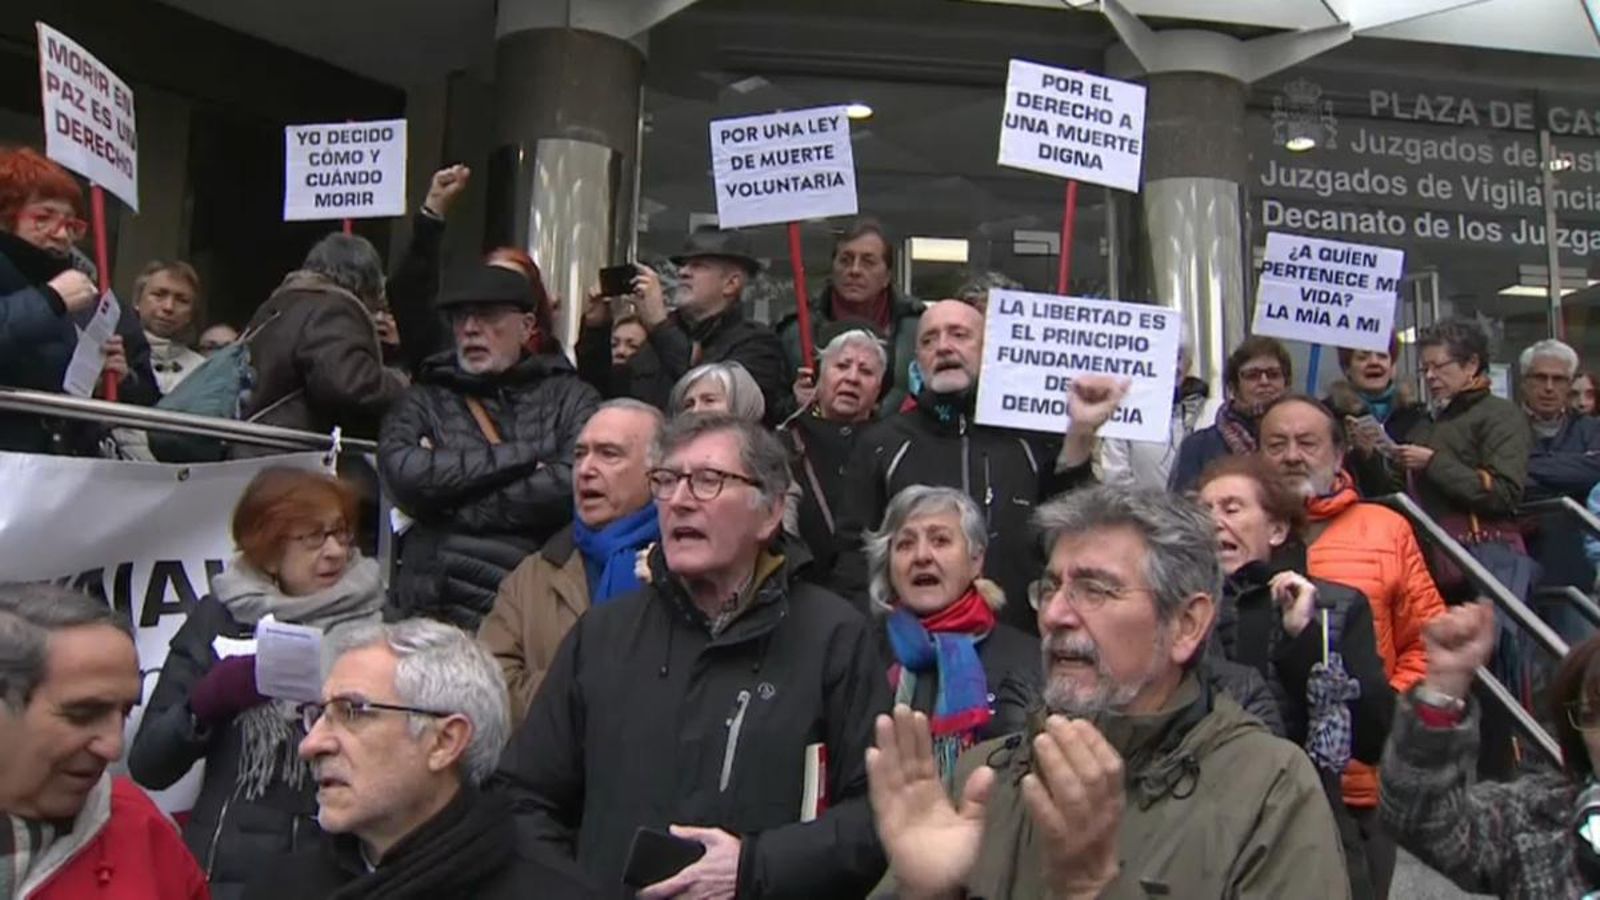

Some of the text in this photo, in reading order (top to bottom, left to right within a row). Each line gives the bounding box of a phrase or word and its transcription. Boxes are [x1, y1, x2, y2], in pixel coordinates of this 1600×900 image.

[47, 36, 131, 117] MORIR EN
[1042, 73, 1113, 102] POR EL
[46, 70, 87, 112] PAZ
[91, 99, 112, 131] ES
[1017, 92, 1133, 130] DERECHO A
[1369, 90, 1479, 126] PLAZA
[1490, 101, 1535, 130] DE
[55, 109, 134, 180] DERECHO
[296, 127, 394, 146] YO DECIDO
[721, 116, 840, 145] POR UNA LEY
[1005, 113, 1140, 155] UNA MUERTE
[309, 147, 381, 167] CÓMO Y
[731, 144, 834, 171] DE MUERTE
[1038, 142, 1103, 171] DIGNA
[1351, 128, 1494, 164] Juzgados
[1503, 141, 1537, 167] de
[305, 168, 383, 187] CUÁNDO
[725, 172, 845, 198] VOLUNTARIA
[1261, 160, 1408, 197] Juzgados
[1417, 173, 1452, 199] de
[314, 191, 374, 208] MORIR
[1262, 200, 1406, 236] Decanato
[1414, 212, 1449, 238] de
[1459, 214, 1502, 242] los
[1288, 244, 1312, 262] ¿A
[1261, 260, 1400, 294] PERTENECE MI
[1300, 287, 1354, 307] VIDA?
[999, 299, 1166, 331] LA LIBERTAD ES
[1266, 303, 1380, 333] LA MÍA A MI
[1011, 324, 1150, 351] EL PRINCIPIO
[997, 346, 1157, 378] FUNDAMENTAL
